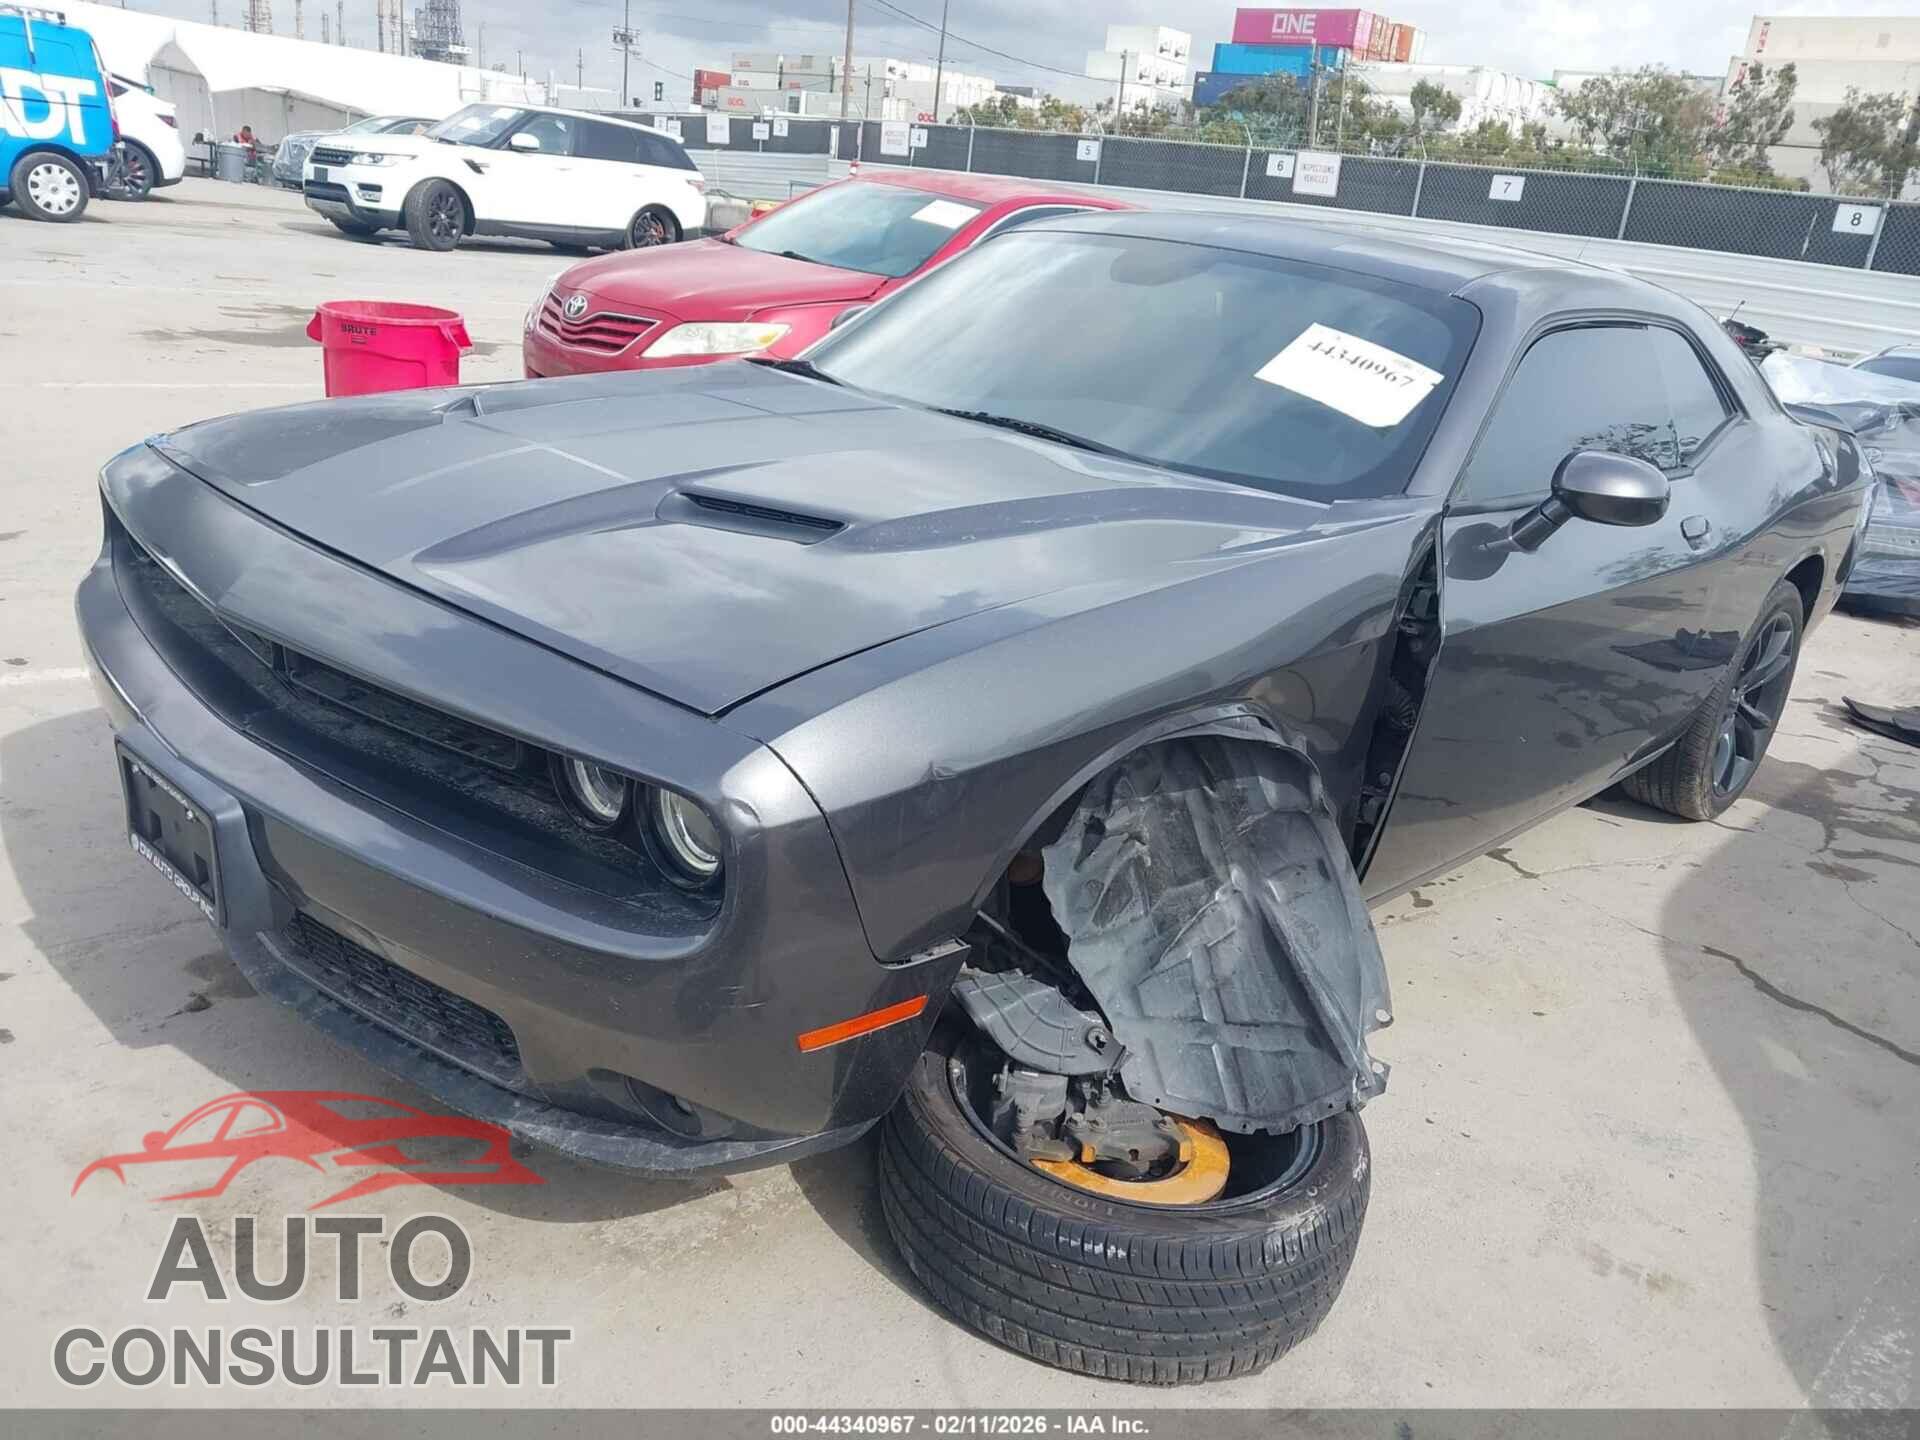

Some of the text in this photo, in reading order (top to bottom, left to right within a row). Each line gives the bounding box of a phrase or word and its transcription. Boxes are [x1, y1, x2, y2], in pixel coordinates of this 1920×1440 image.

[1272, 14, 1316, 33] ONE
[1084, 145, 1090, 156] 5
[1276, 160, 1285, 172] 6
[1503, 181, 1512, 194] 7
[1851, 212, 1862, 226] 8
[341, 323, 377, 336] BRUTE
[1307, 341, 1415, 388] 44340967
[153, 855, 173, 881] AUTO
[174, 873, 200, 902] GROUP
